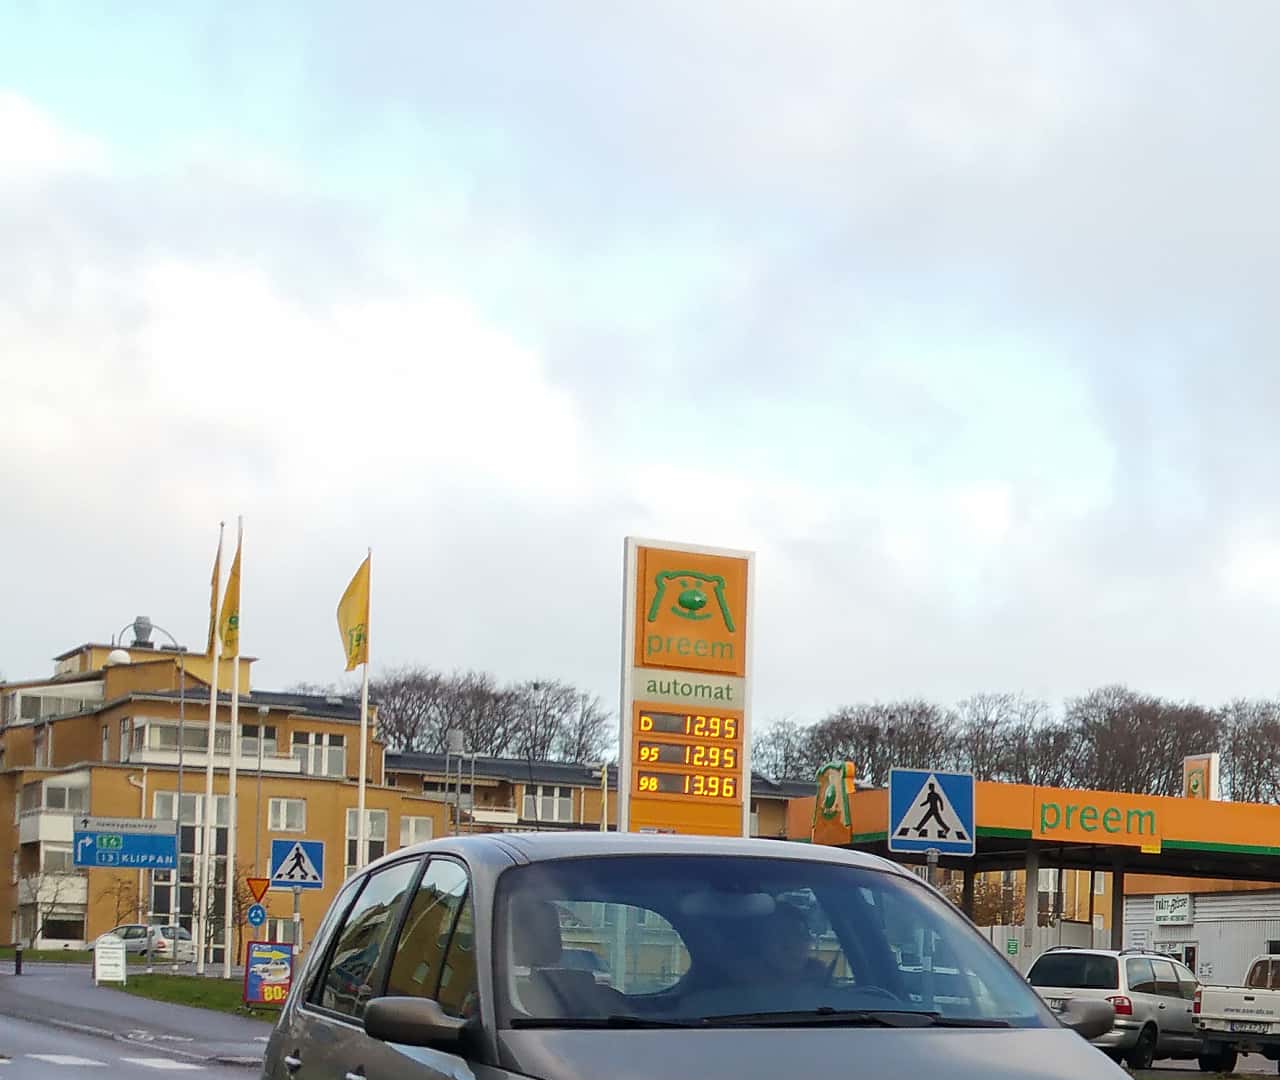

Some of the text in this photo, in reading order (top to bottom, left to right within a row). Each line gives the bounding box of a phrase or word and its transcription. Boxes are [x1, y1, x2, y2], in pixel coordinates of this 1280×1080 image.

[647, 635, 734, 659] preem
[647, 679, 733, 701] automat
[641, 715, 735, 739] D 12.95
[640, 745, 735, 768] 95 12.95
[639, 775, 734, 798] 98 13.96
[1040, 802, 1156, 835] preem
[121, 854, 173, 864] KLIPPAN
